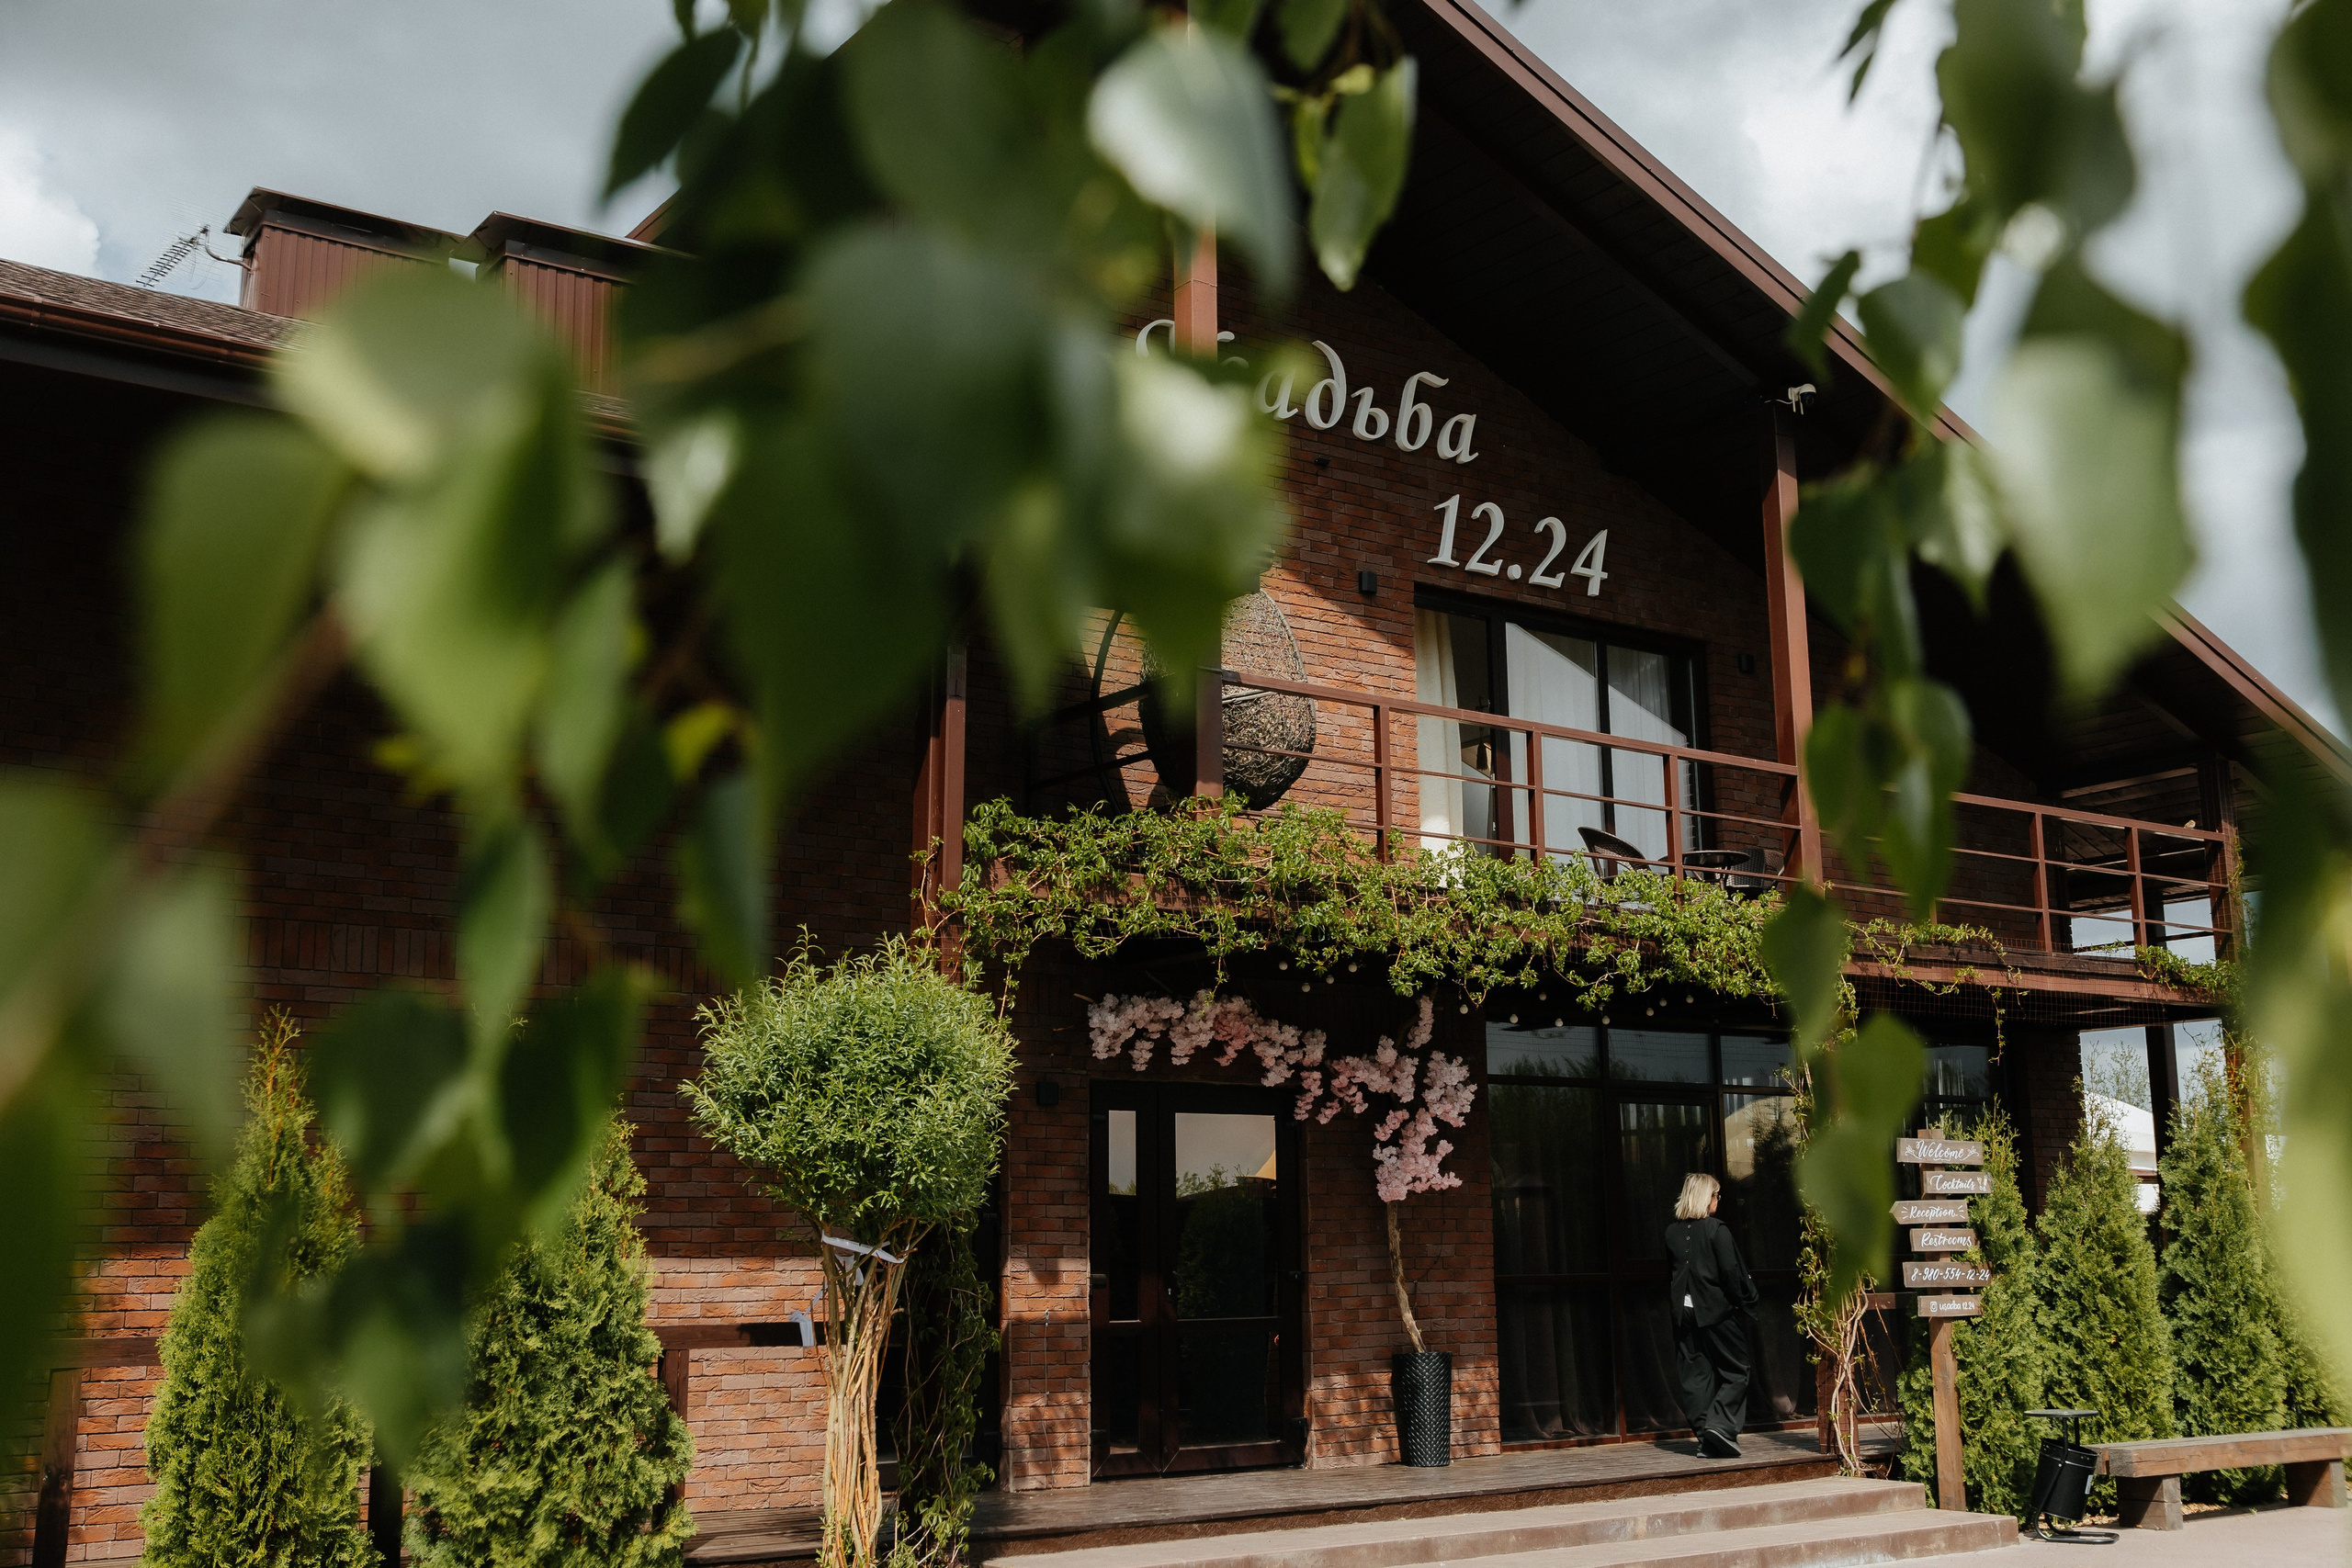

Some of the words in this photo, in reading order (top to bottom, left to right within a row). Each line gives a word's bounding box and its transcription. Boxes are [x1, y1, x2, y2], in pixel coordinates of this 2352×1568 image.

[1136, 319, 1479, 465] адьба
[1426, 493, 1609, 597] 12.24
[1916, 1139, 1964, 1159] Welcome
[1929, 1174, 1976, 1190] Cocktails
[1920, 1231, 1973, 1247] Restrooms
[1910, 1267, 1990, 1281] 8-980-554-12-24
